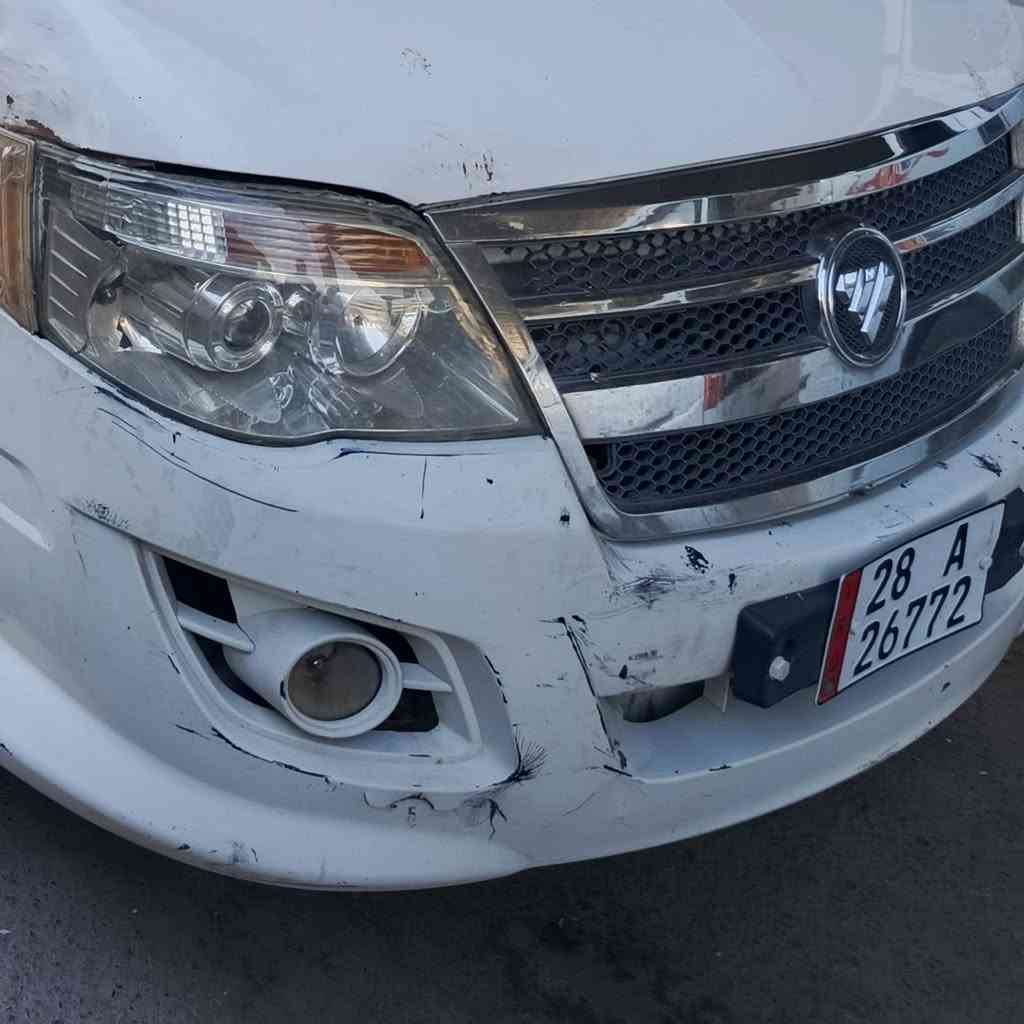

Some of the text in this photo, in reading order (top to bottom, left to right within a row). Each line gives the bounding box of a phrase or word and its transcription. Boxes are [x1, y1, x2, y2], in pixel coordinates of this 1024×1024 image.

[865, 522, 969, 616] 28 A
[853, 575, 972, 677] 26772
